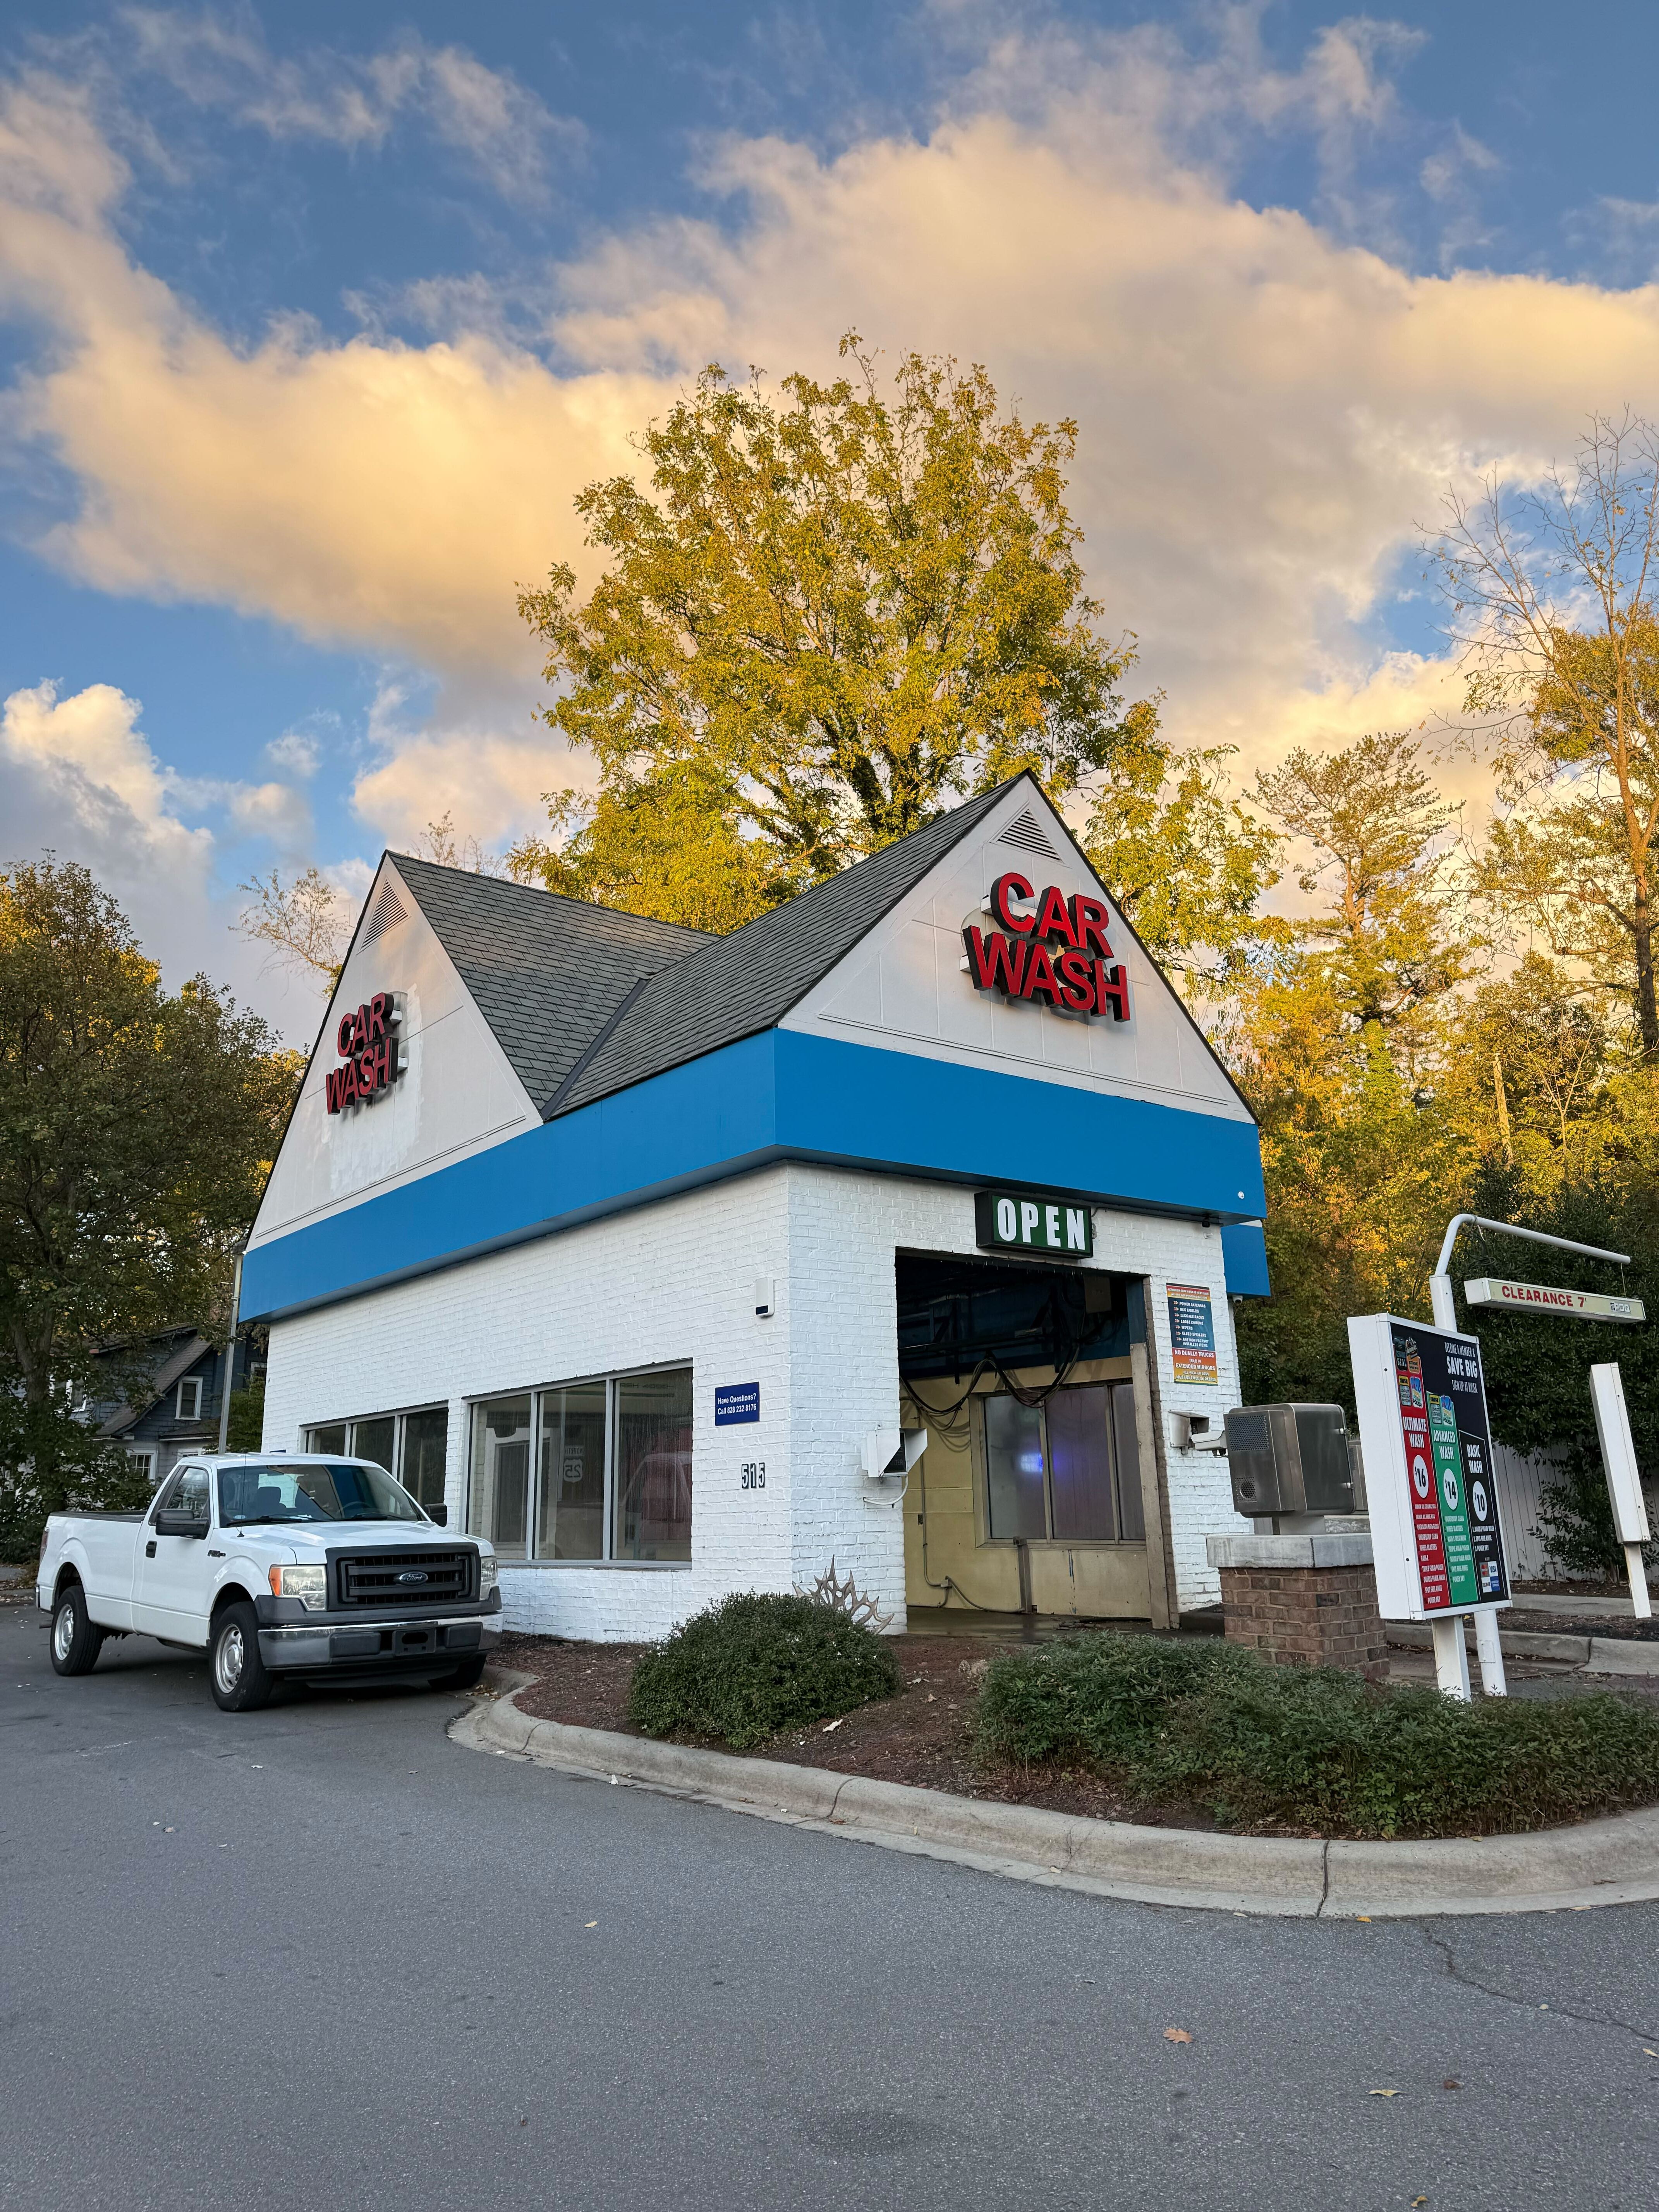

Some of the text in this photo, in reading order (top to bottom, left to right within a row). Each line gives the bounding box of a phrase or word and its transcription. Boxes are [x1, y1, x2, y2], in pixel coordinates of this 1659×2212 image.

[991, 872, 1115, 958] CAR
[963, 926, 1130, 1022] WASH
[338, 993, 391, 1057] CAR
[326, 1037, 397, 1115] WASH
[997, 1198, 1085, 1250] OPEN
[1502, 1285, 1587, 1308] CLEARANCE 7'
[1444, 1342, 1476, 1358] BECOME A MEMBER &
[1446, 1356, 1478, 1378] SAVE BIG
[1452, 1380, 1478, 1393] SIGN UP AT KIOSK
[730, 1393, 756, 1403] Questions?
[1403, 1416, 1427, 1432] ULTIMATE
[1409, 1433, 1425, 1448] WASH
[1434, 1430, 1455, 1443] ADVANCED
[1439, 1446, 1454, 1460] WASH
[1467, 1444, 1481, 1458] BASIC
[741, 1463, 765, 1488] 515
[1415, 1466, 1426, 1487] $16
[1468, 1460, 1483, 1474] WASH
[1445, 1479, 1456, 1499] $14
[1474, 1492, 1485, 1512] $10
[407, 1573, 422, 1582] Ford
